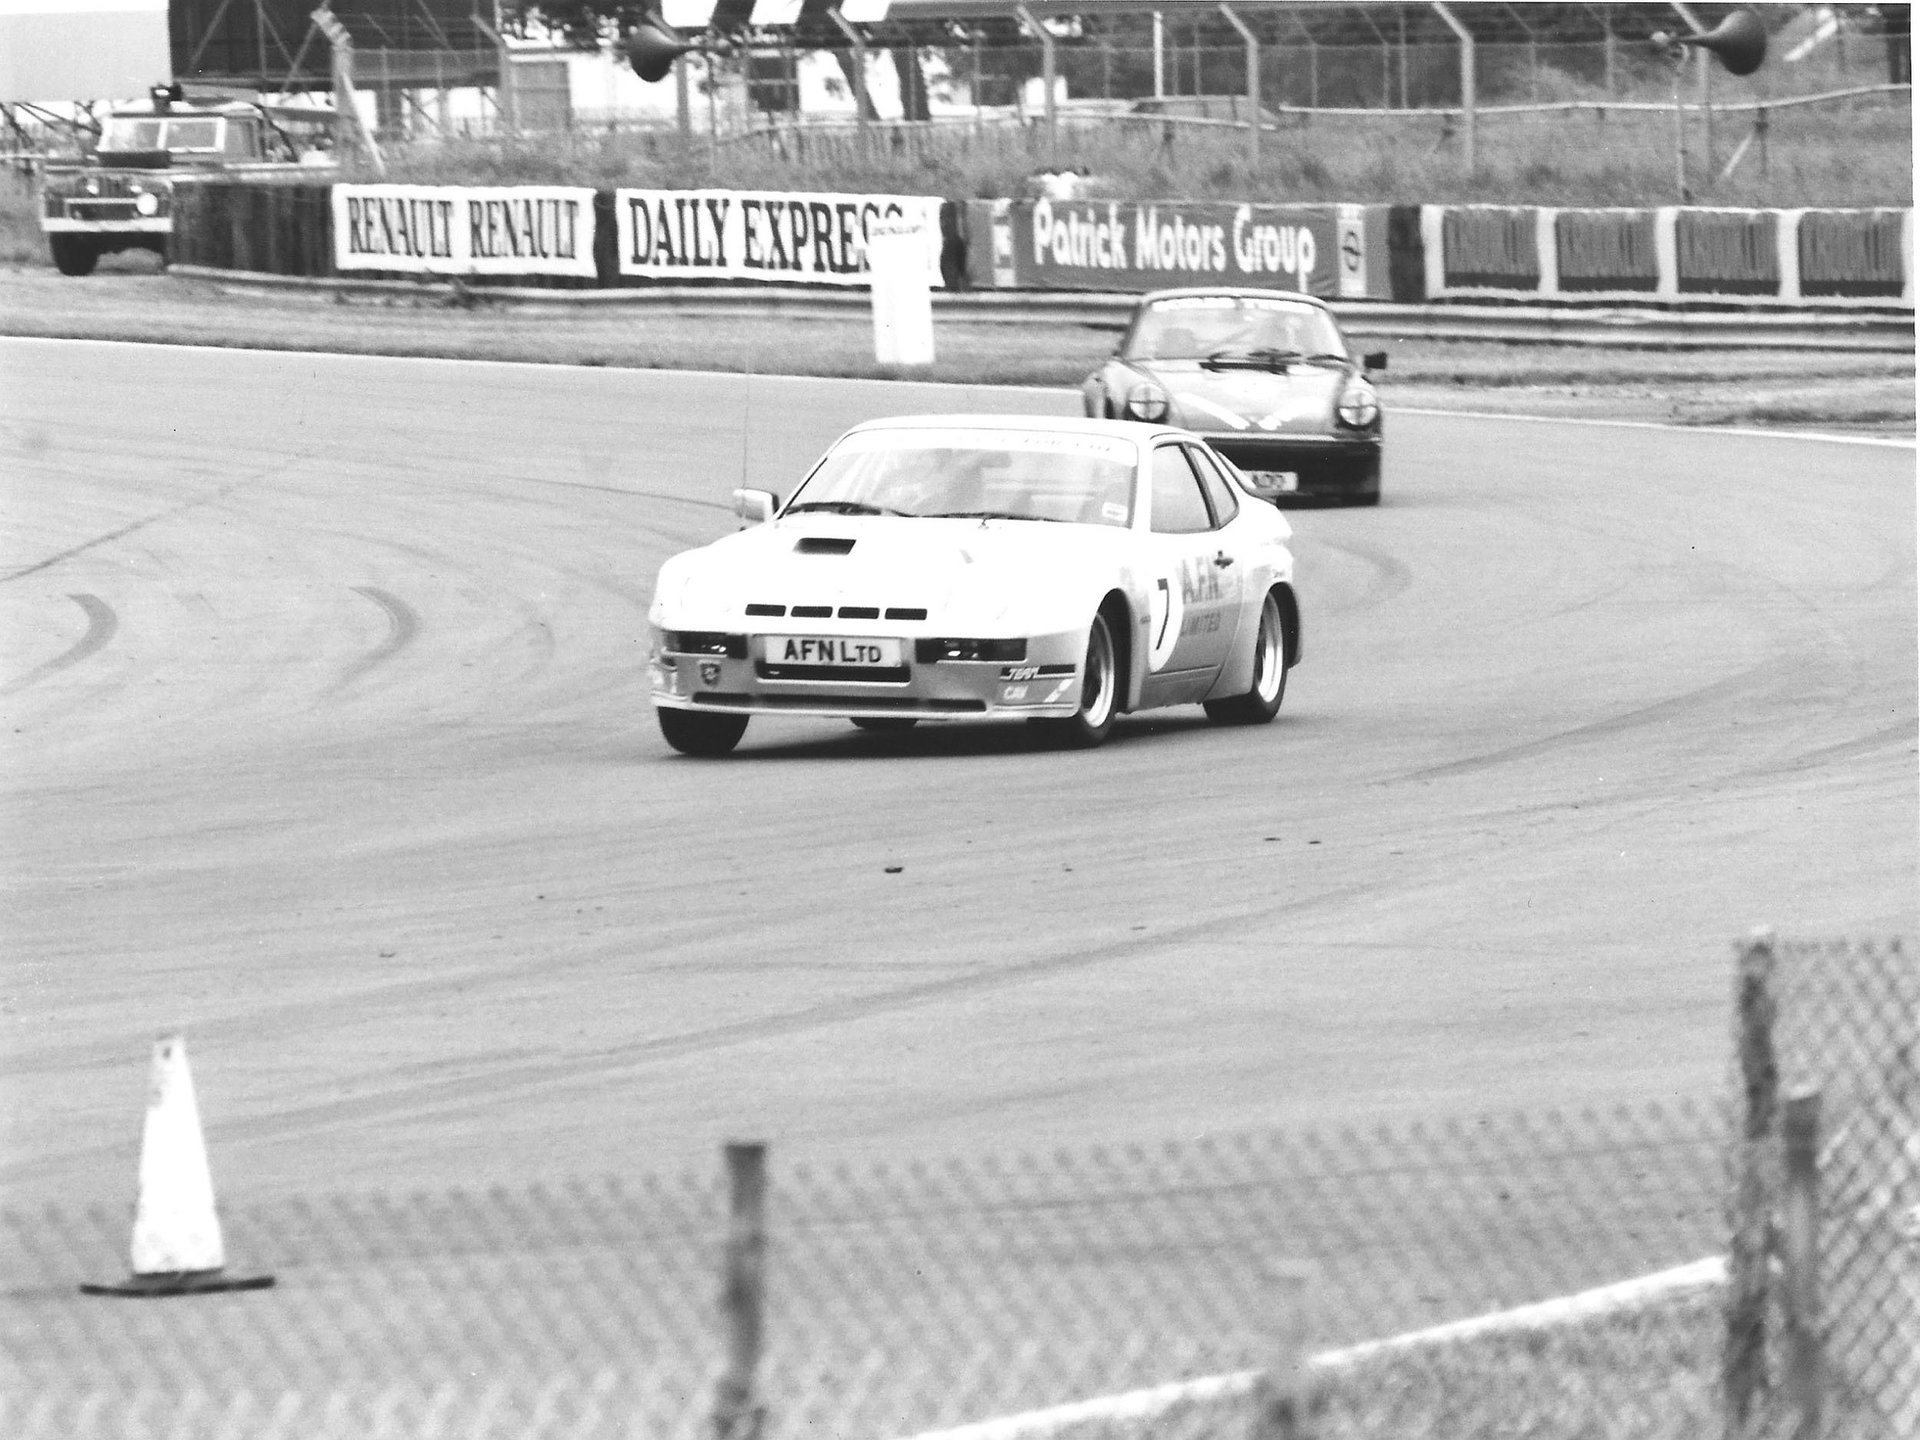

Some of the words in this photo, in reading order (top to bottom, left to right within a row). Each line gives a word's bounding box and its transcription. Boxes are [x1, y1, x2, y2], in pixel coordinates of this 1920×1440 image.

[347, 197, 452, 257] RENAULT
[469, 199, 578, 259] RENAULT
[629, 198, 730, 266] DAILY
[741, 199, 904, 272] EXPRE
[1033, 197, 1127, 269] Patrick
[1136, 205, 1227, 272] Motors
[1233, 203, 1316, 294] Group
[784, 638, 834, 661] AFN
[1157, 578, 1170, 650] 7
